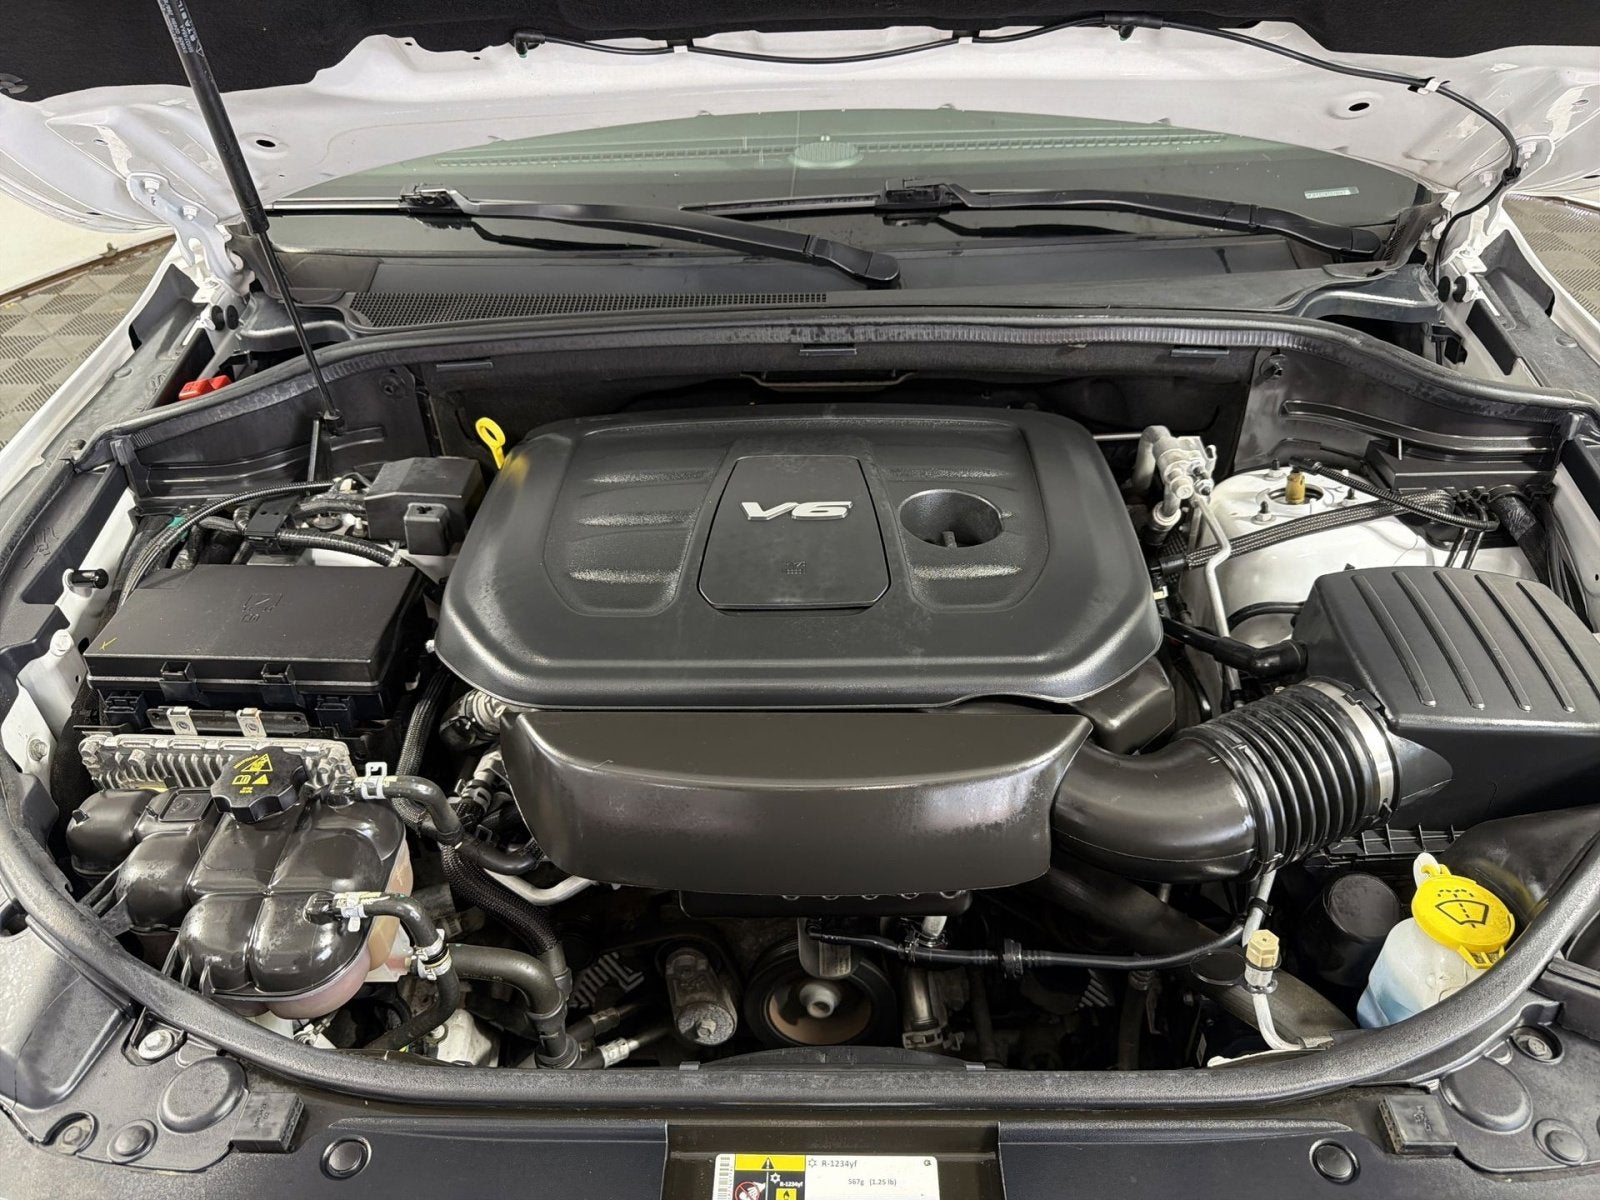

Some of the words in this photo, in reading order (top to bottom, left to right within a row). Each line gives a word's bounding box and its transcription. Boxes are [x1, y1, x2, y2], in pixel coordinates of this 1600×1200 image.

[741, 501, 853, 520] V6
[821, 1159, 857, 1169] R-1234yf
[848, 1178, 865, 1186] 567g
